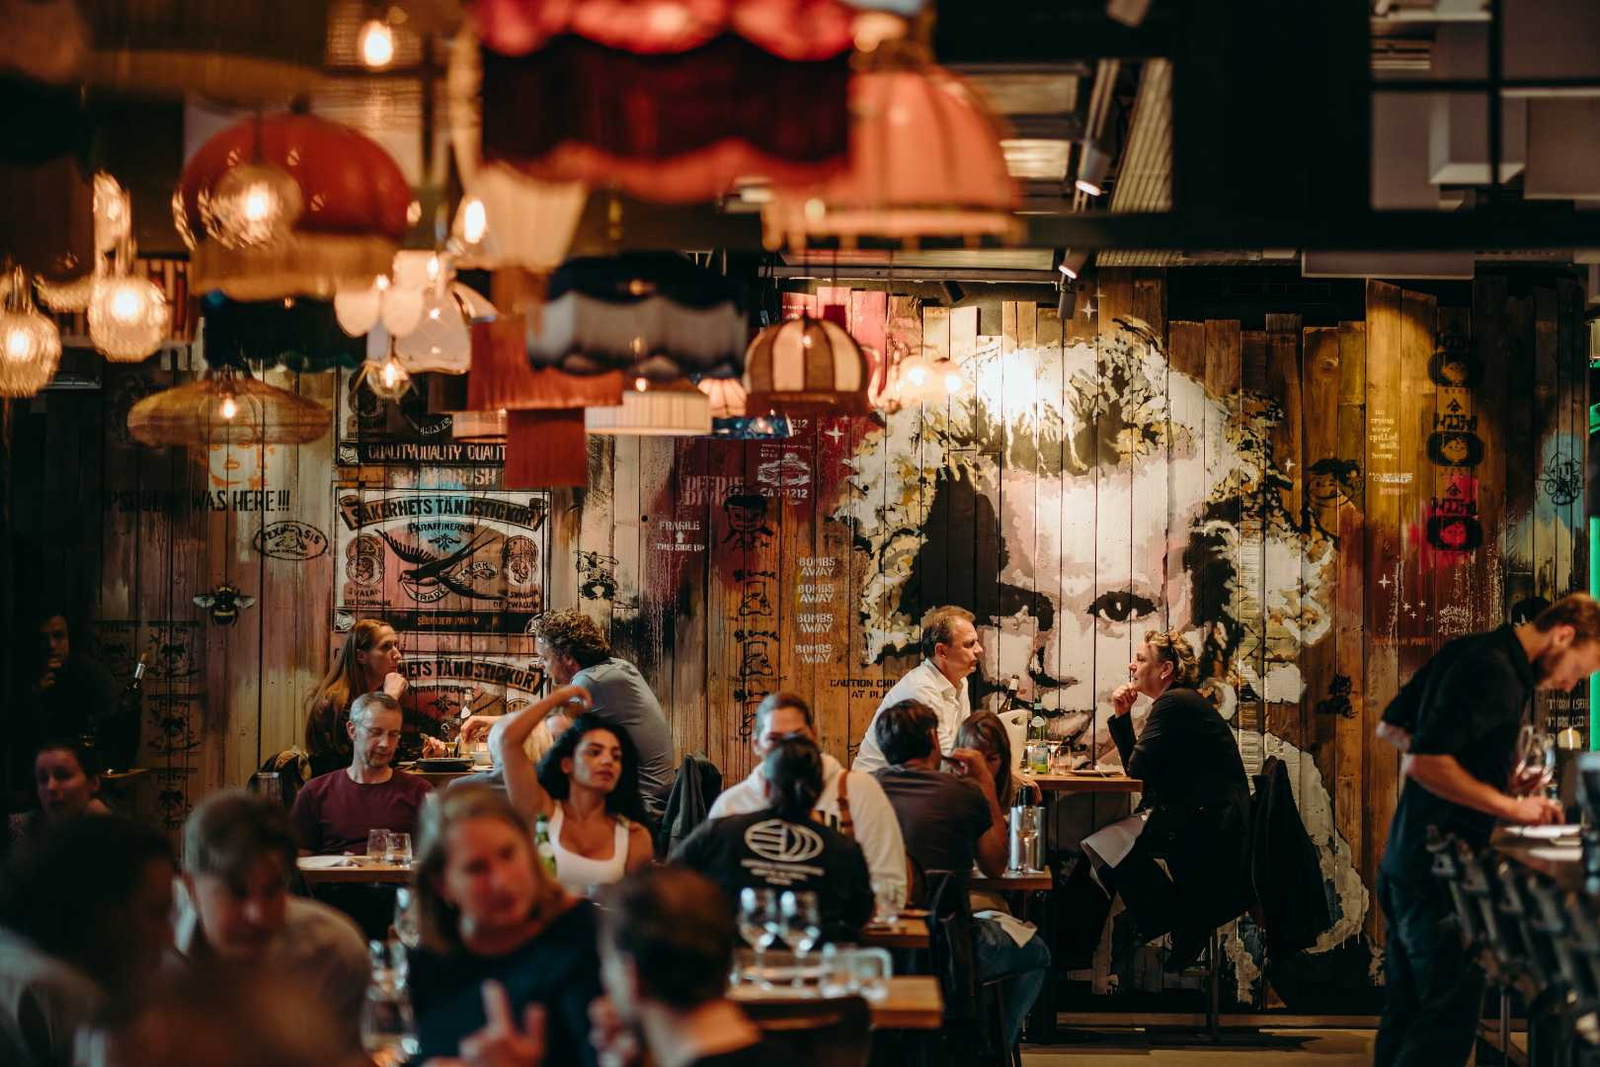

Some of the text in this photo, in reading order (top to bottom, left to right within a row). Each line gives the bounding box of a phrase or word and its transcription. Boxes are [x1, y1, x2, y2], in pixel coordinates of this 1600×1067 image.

[368, 444, 507, 460] QUALITY QUALITY QUALIT
[192, 490, 226, 512] WAS
[436, 496, 532, 526] TÄNDSTICKOR
[659, 520, 700, 531] FRAGILE
[657, 543, 706, 552] THIS SIDE UP
[799, 557, 836, 567] BOMBS
[800, 567, 834, 577] AWAY
[798, 584, 835, 594] BOMBS
[799, 594, 833, 603] AWAY
[798, 613, 834, 623] BOMBS
[795, 644, 832, 654] BOMBS
[436, 658, 534, 690] TÄNDSTICKOR
[830, 679, 873, 688] CAUTION
[852, 690, 865, 699] AT
